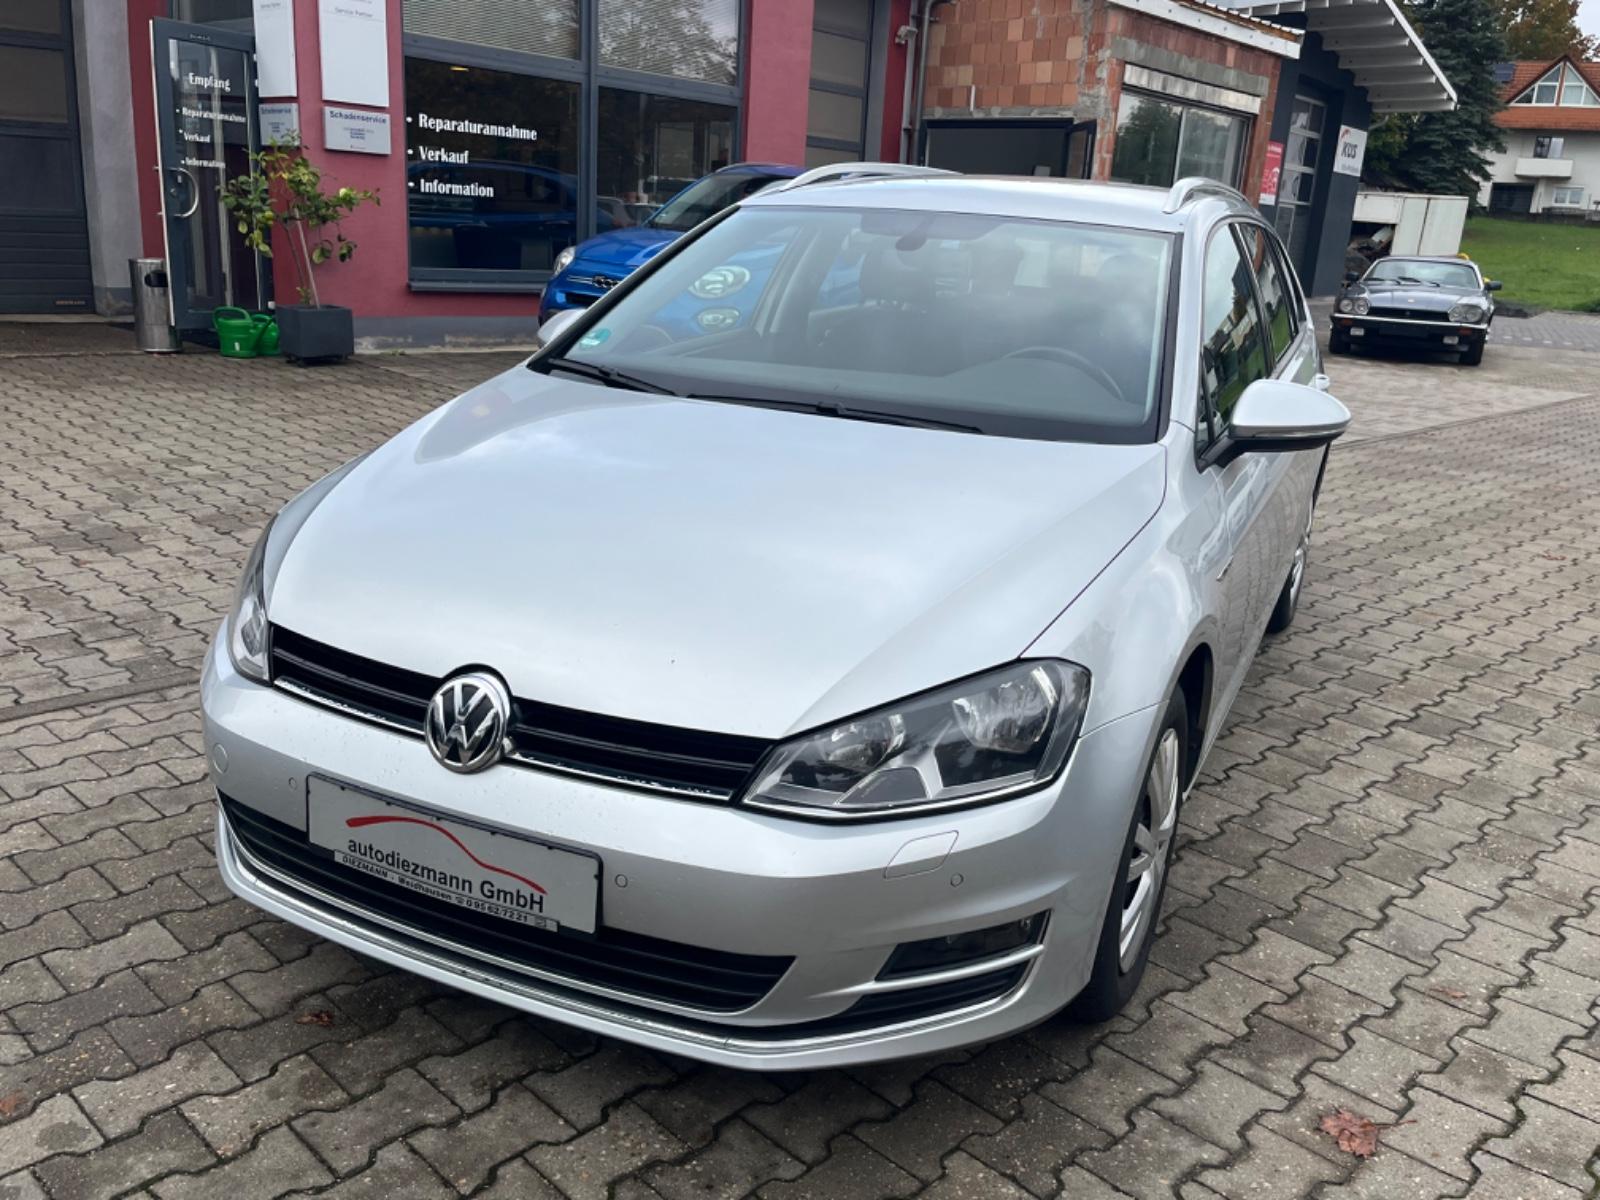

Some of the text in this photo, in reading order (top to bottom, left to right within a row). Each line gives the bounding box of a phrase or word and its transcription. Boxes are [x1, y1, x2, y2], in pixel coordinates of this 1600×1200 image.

[188, 72, 231, 92] Empfang
[329, 110, 387, 124] Schadenservice
[418, 112, 538, 141] Reparaturannahme
[418, 145, 470, 164] Verkauf
[419, 178, 495, 198] Information
[347, 839, 544, 913] autodiezmann GmbH
